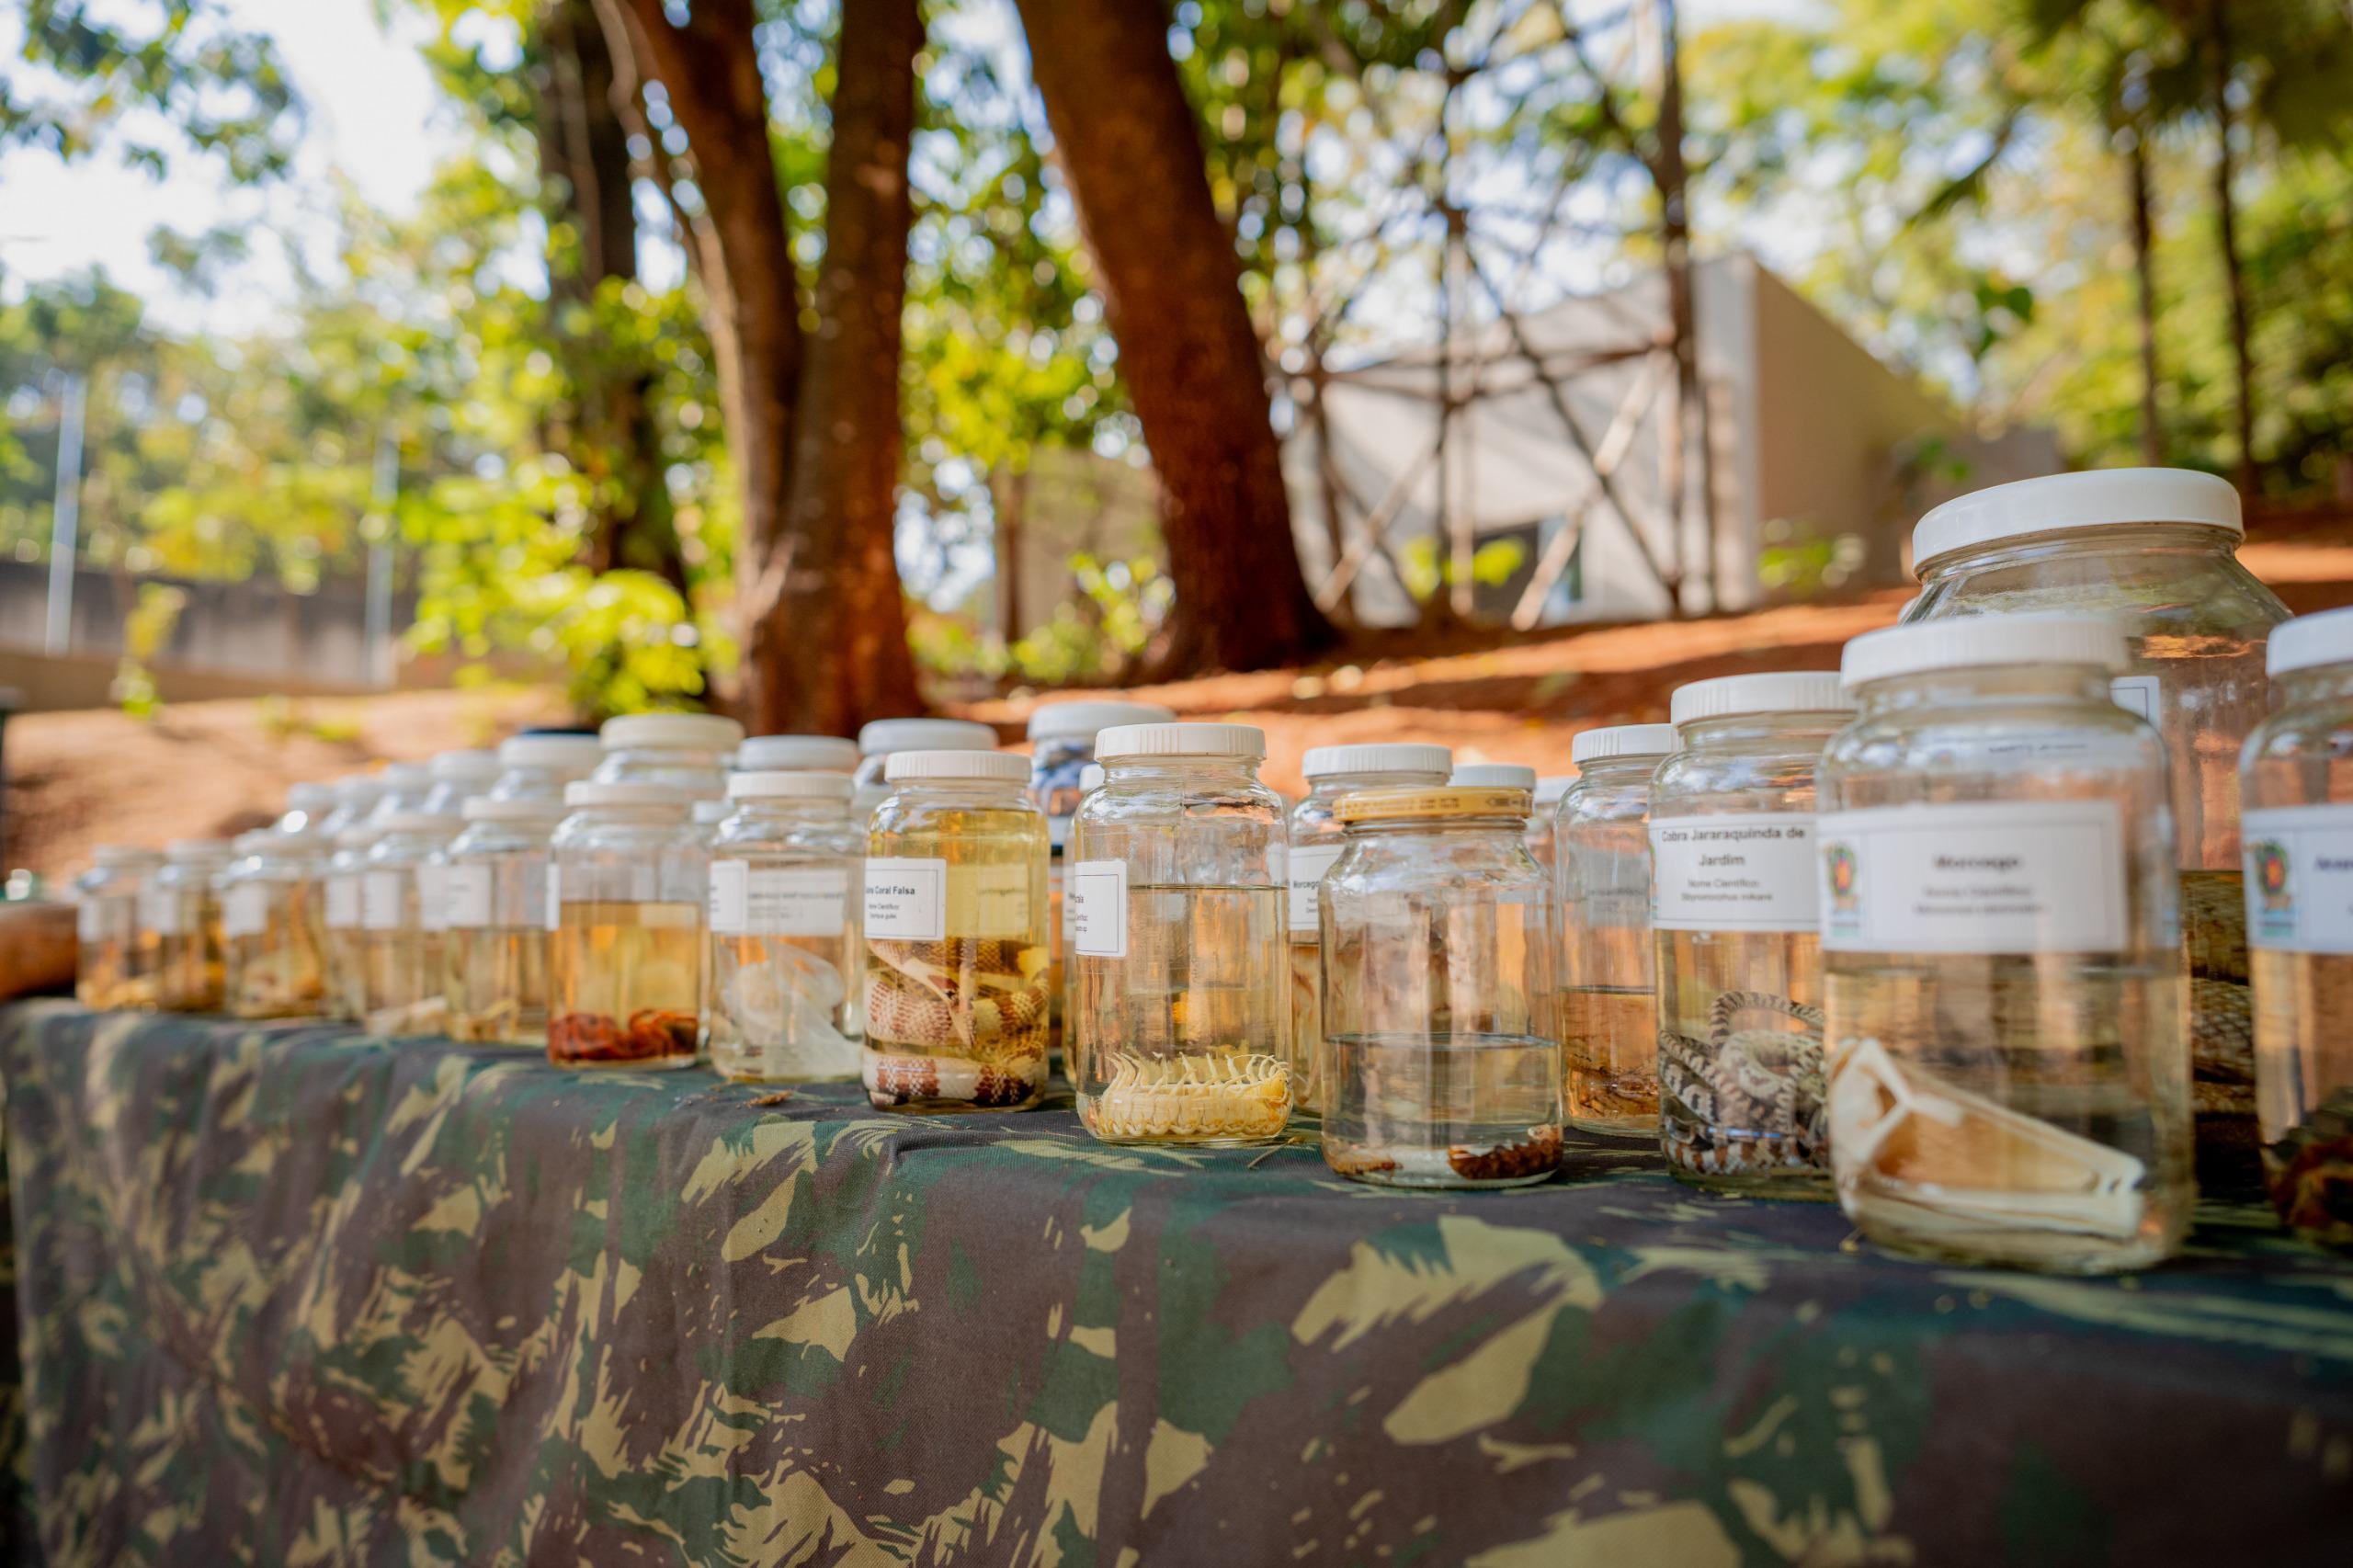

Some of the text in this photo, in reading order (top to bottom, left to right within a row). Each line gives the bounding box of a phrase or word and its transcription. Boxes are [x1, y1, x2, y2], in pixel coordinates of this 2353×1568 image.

[1661, 831, 1688, 843] Cobra
[1786, 826, 1807, 839] de
[1699, 854, 1746, 867] Jardim
[892, 885, 916, 895] Falsa
